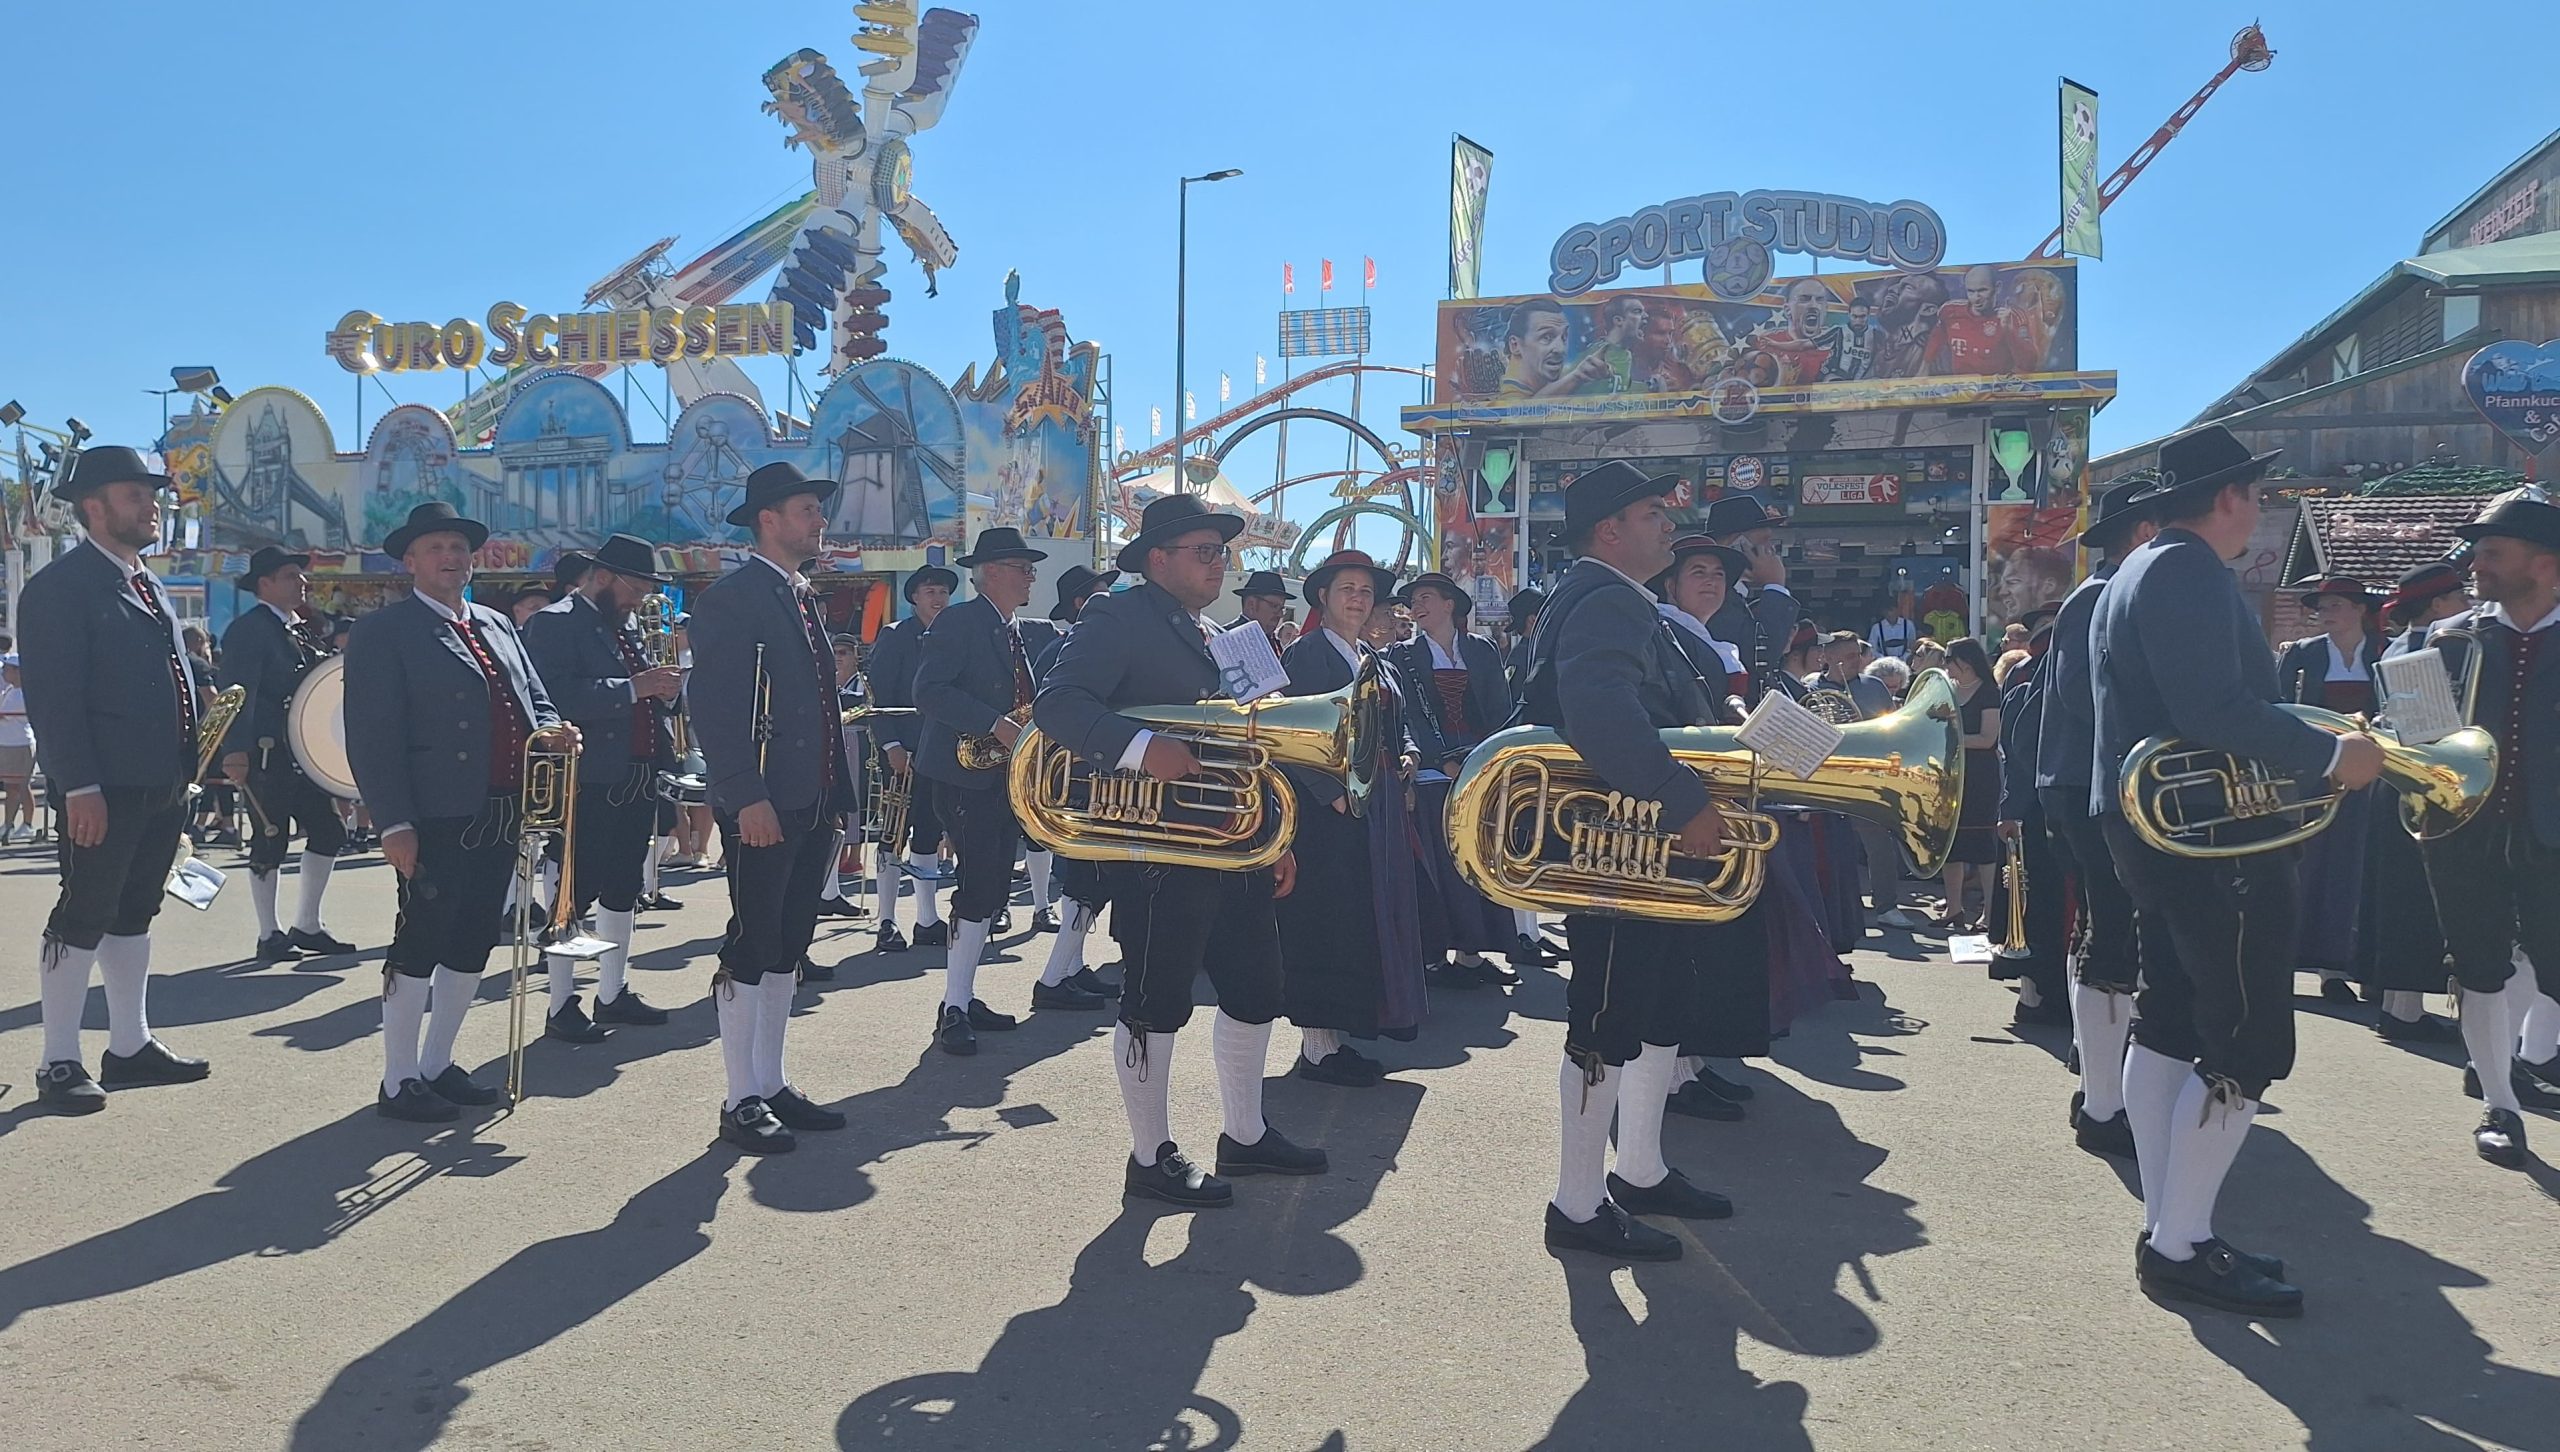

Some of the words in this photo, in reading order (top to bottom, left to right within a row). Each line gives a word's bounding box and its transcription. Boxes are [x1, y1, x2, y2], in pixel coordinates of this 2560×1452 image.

[1553, 198, 1733, 292] SPORT
[1741, 196, 1940, 266] STUDIO
[486, 301, 792, 367] SCHIESSEN
[1843, 347, 1871, 361] Jeep
[2524, 409, 2542, 424] &
[1816, 482, 1865, 491] VOLKSFEST
[1840, 491, 1865, 500] LIGA
